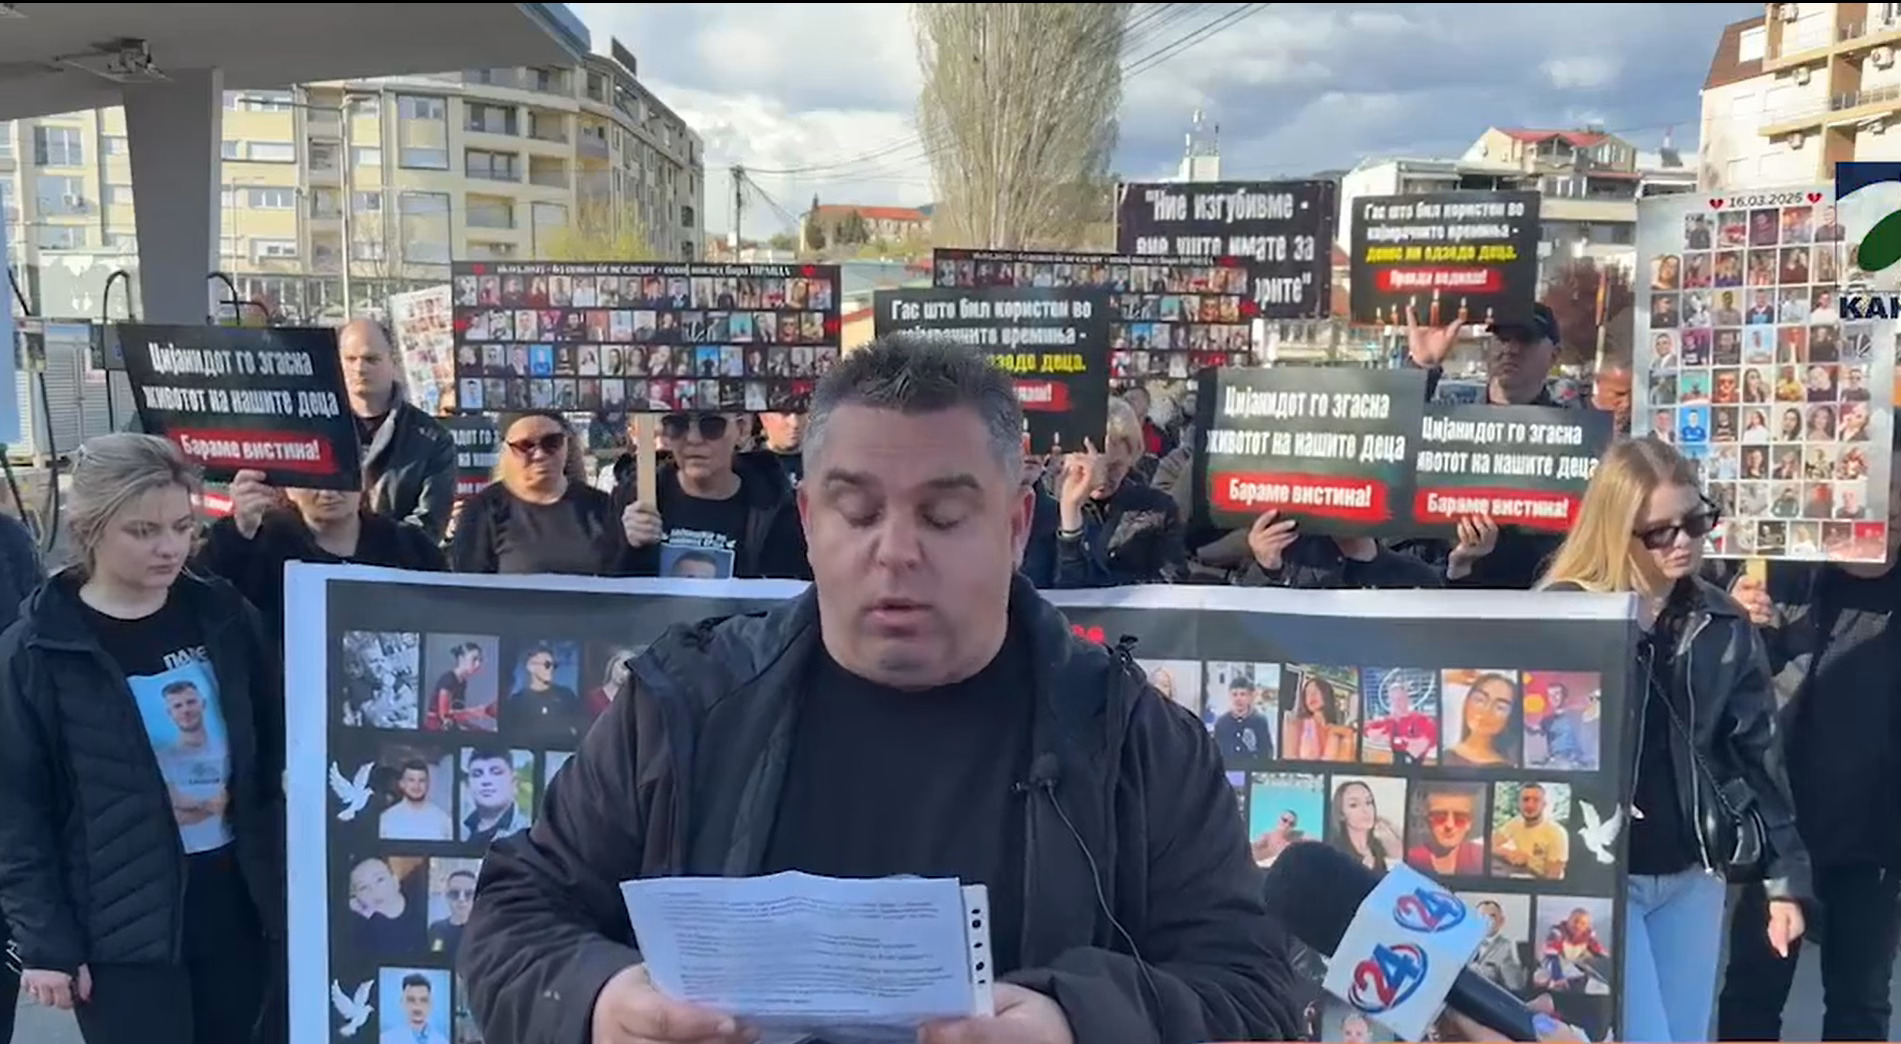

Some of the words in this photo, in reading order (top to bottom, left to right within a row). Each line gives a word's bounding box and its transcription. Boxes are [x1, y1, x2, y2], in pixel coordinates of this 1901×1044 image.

[1145, 189, 1187, 221] "Ние
[1194, 188, 1293, 224] изгубивме
[1363, 203, 1386, 220] Гас
[1294, 235, 1315, 261] за
[891, 300, 919, 320] Гас
[923, 302, 956, 320] што
[960, 298, 990, 319] бил
[994, 300, 1069, 322] користен
[1072, 300, 1092, 318] во
[148, 342, 232, 377] Цијанидот
[236, 350, 256, 375] го
[259, 351, 314, 376] згасна
[142, 386, 205, 412] животот
[208, 389, 231, 414] на
[230, 389, 294, 415] нашите
[297, 390, 340, 418] деца
[1224, 386, 1306, 420] Цијанидот
[1309, 392, 1330, 418] го
[1332, 393, 1391, 419] згасна
[1421, 416, 1505, 445] Цијанидот
[1507, 423, 1526, 442] го
[1529, 424, 1583, 445] згасна
[180, 434, 241, 461] Бараме
[242, 439, 320, 461] вистина!
[1206, 429, 1271, 455] животот
[1271, 431, 1292, 455] на
[1294, 432, 1357, 458] нашите
[1359, 433, 1406, 463] деца
[1471, 452, 1490, 474] на
[1493, 453, 1553, 477] нашите
[1229, 478, 1290, 505] Бараме
[1292, 484, 1372, 508] вистина!
[1427, 492, 1489, 518] Бараме
[1491, 497, 1570, 519] вистина!
[1396, 886, 1460, 931] 24
[1353, 943, 1421, 1006] 24
